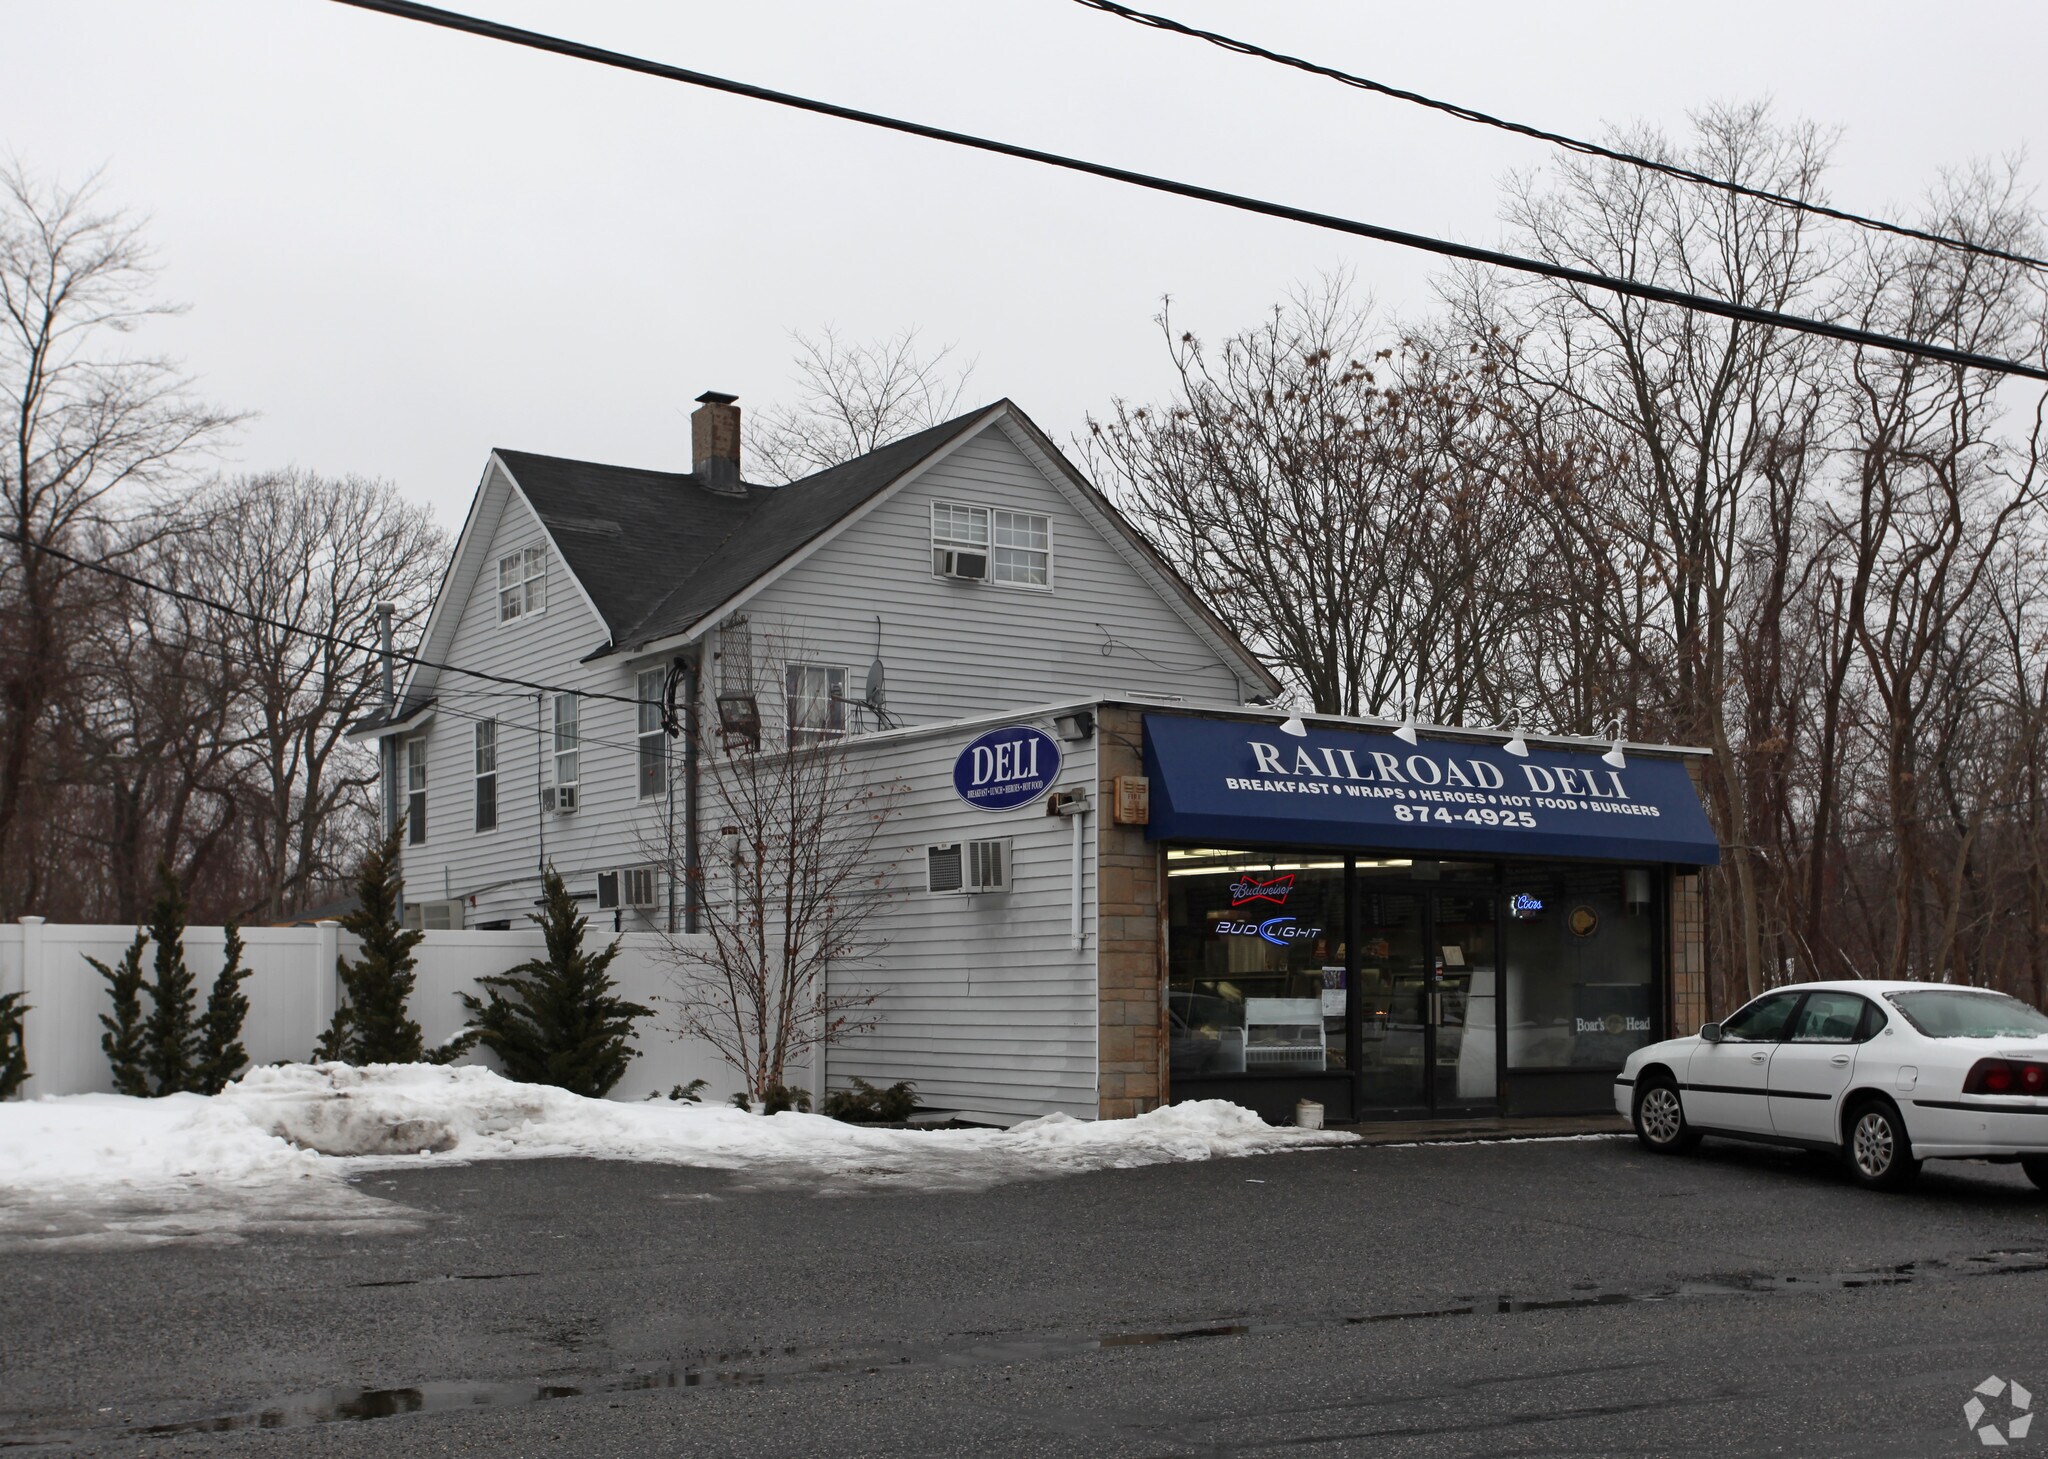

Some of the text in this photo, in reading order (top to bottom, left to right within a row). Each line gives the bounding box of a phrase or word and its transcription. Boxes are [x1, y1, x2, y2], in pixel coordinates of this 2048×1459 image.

[972, 738, 1039, 785] DELI
[1247, 741, 1631, 800] RAILROAD DELI
[968, 788, 988, 798] BREAKFAST
[1005, 784, 1020, 793] HEROES
[1022, 782, 1031, 790] HOT
[1032, 780, 1043, 789] FOOD
[1225, 777, 1661, 817] BREAKFAST WRAPS HEROES HOT FOOD BURGERS
[1393, 804, 1537, 828] 874-4925
[1229, 883, 1293, 899] Budweiser
[1517, 895, 1543, 910] Coors
[1215, 921, 1322, 939] BUD LIGHT
[1576, 1016, 1651, 1032] Boar's Head
